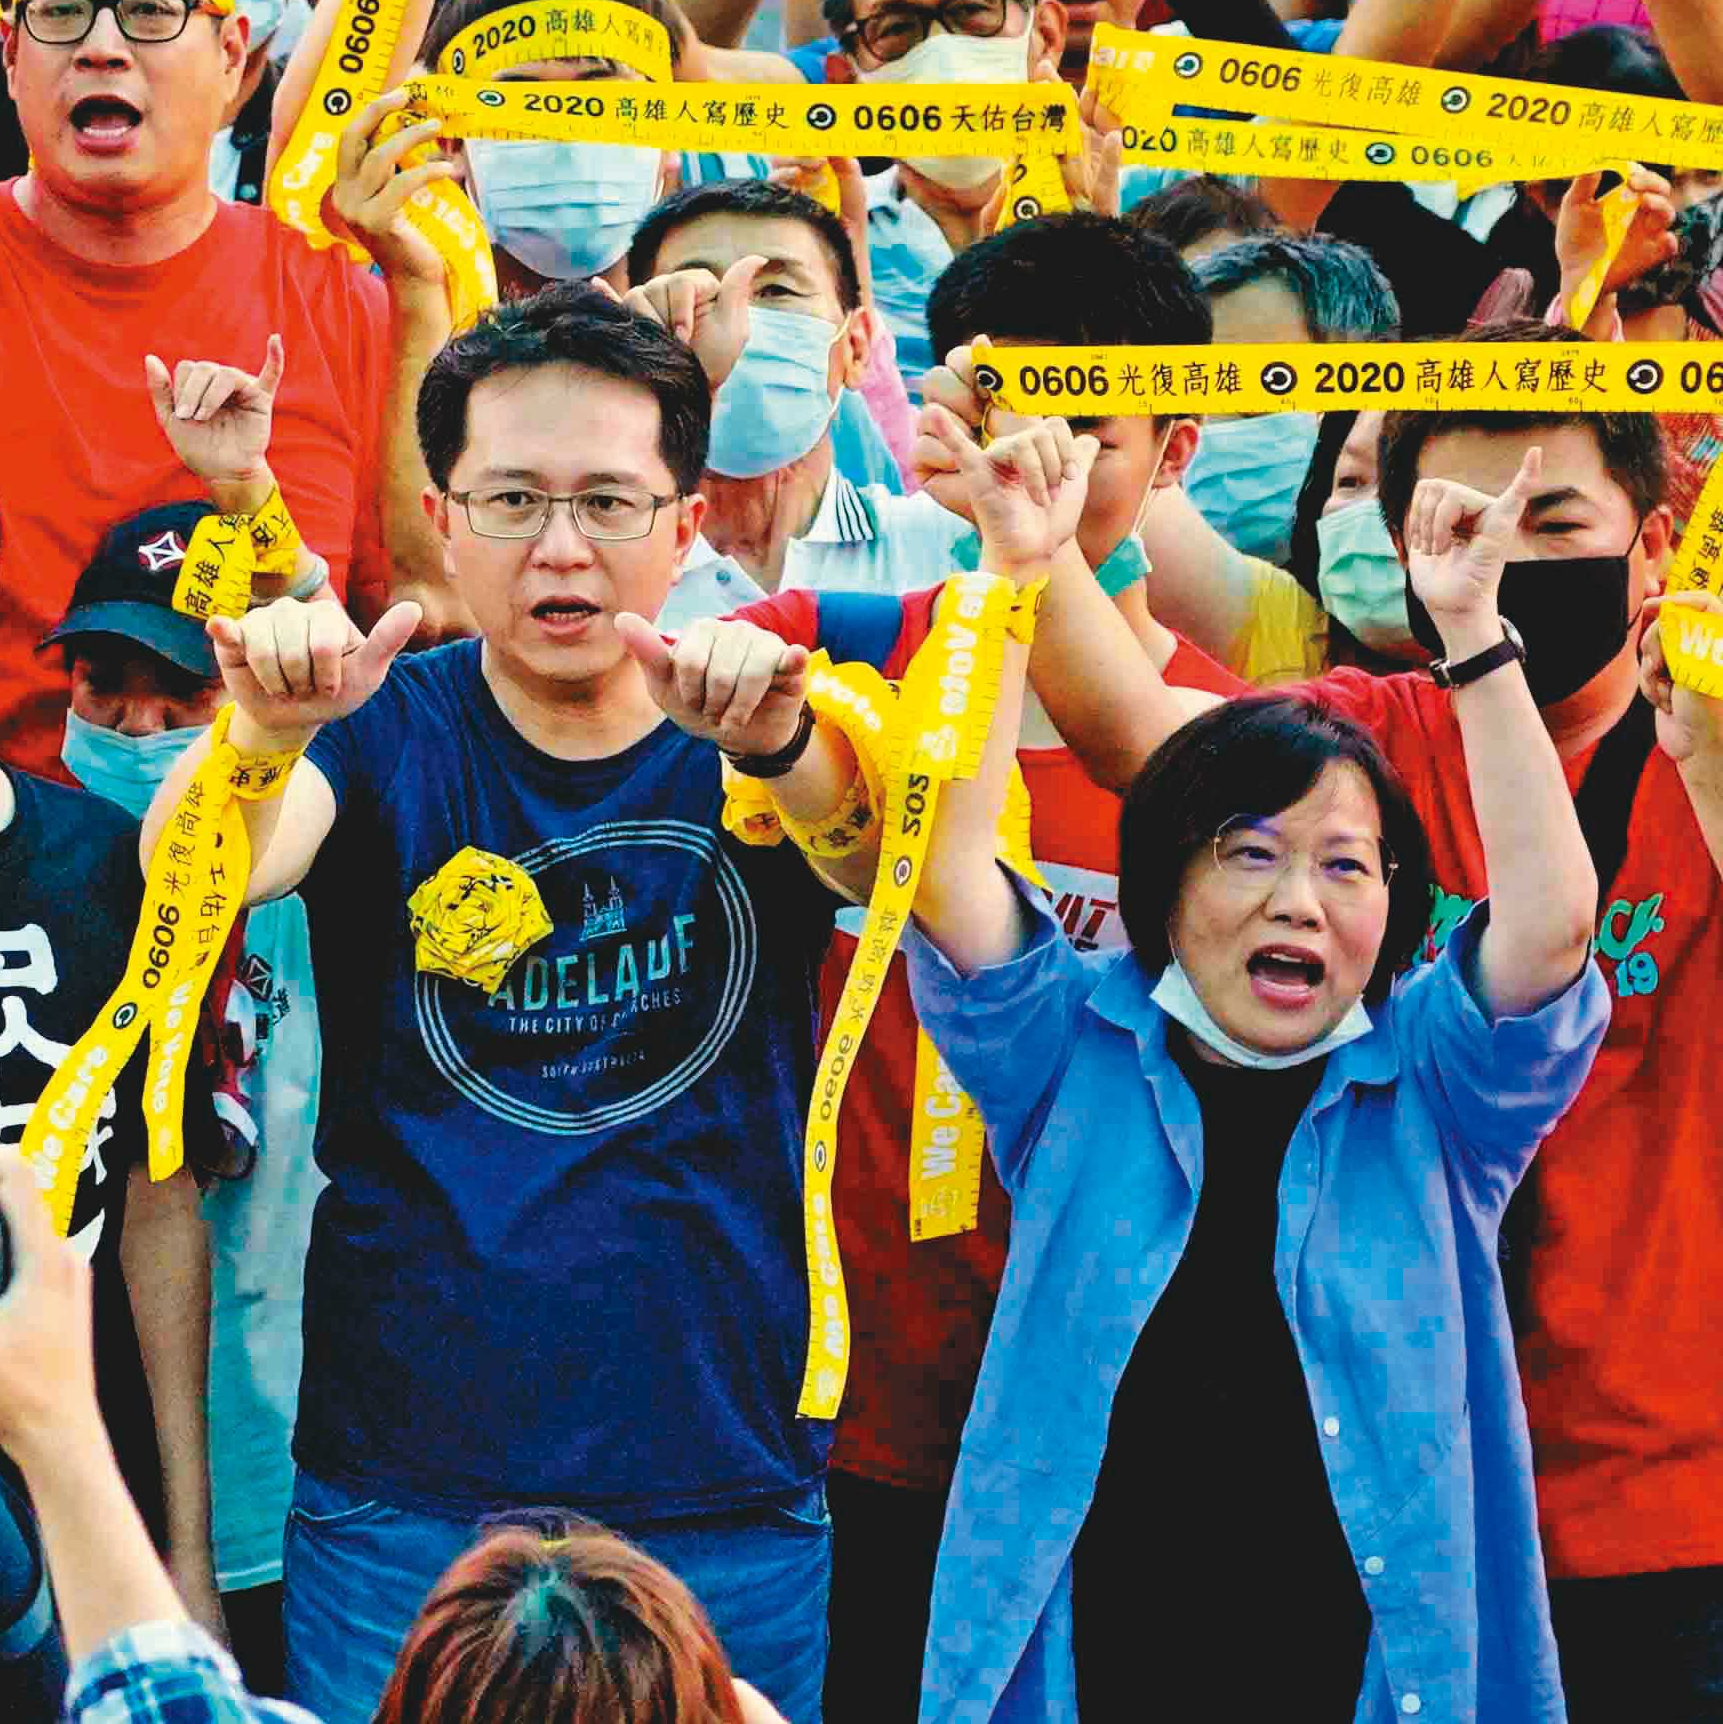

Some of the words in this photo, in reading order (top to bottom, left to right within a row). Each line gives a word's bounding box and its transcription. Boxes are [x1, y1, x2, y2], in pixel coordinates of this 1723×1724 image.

[472, 14, 537, 60] 2020
[524, 92, 605, 119] 2020
[614, 95, 793, 131] 高雄人寫歷史
[852, 104, 942, 132] 0606
[948, 105, 1067, 138] 天佑台灣
[1219, 57, 1302, 94] 0606
[1310, 66, 1422, 108] 光復高雄
[1486, 91, 1571, 129] 2020
[1185, 128, 1350, 166] 高雄人寫歷史
[1410, 144, 1495, 170] 0606
[1018, 365, 1110, 398] 0606
[1116, 362, 1244, 398] 光復高雄
[1314, 362, 1405, 396] 2020
[1415, 358, 1608, 396] 高雄人寫歷史
[50, 1042, 107, 1132] Care
[141, 904, 183, 990] 0606
[509, 1017, 538, 1034] THE
[545, 1015, 583, 1034] CITY
[921, 1123, 957, 1181] We
